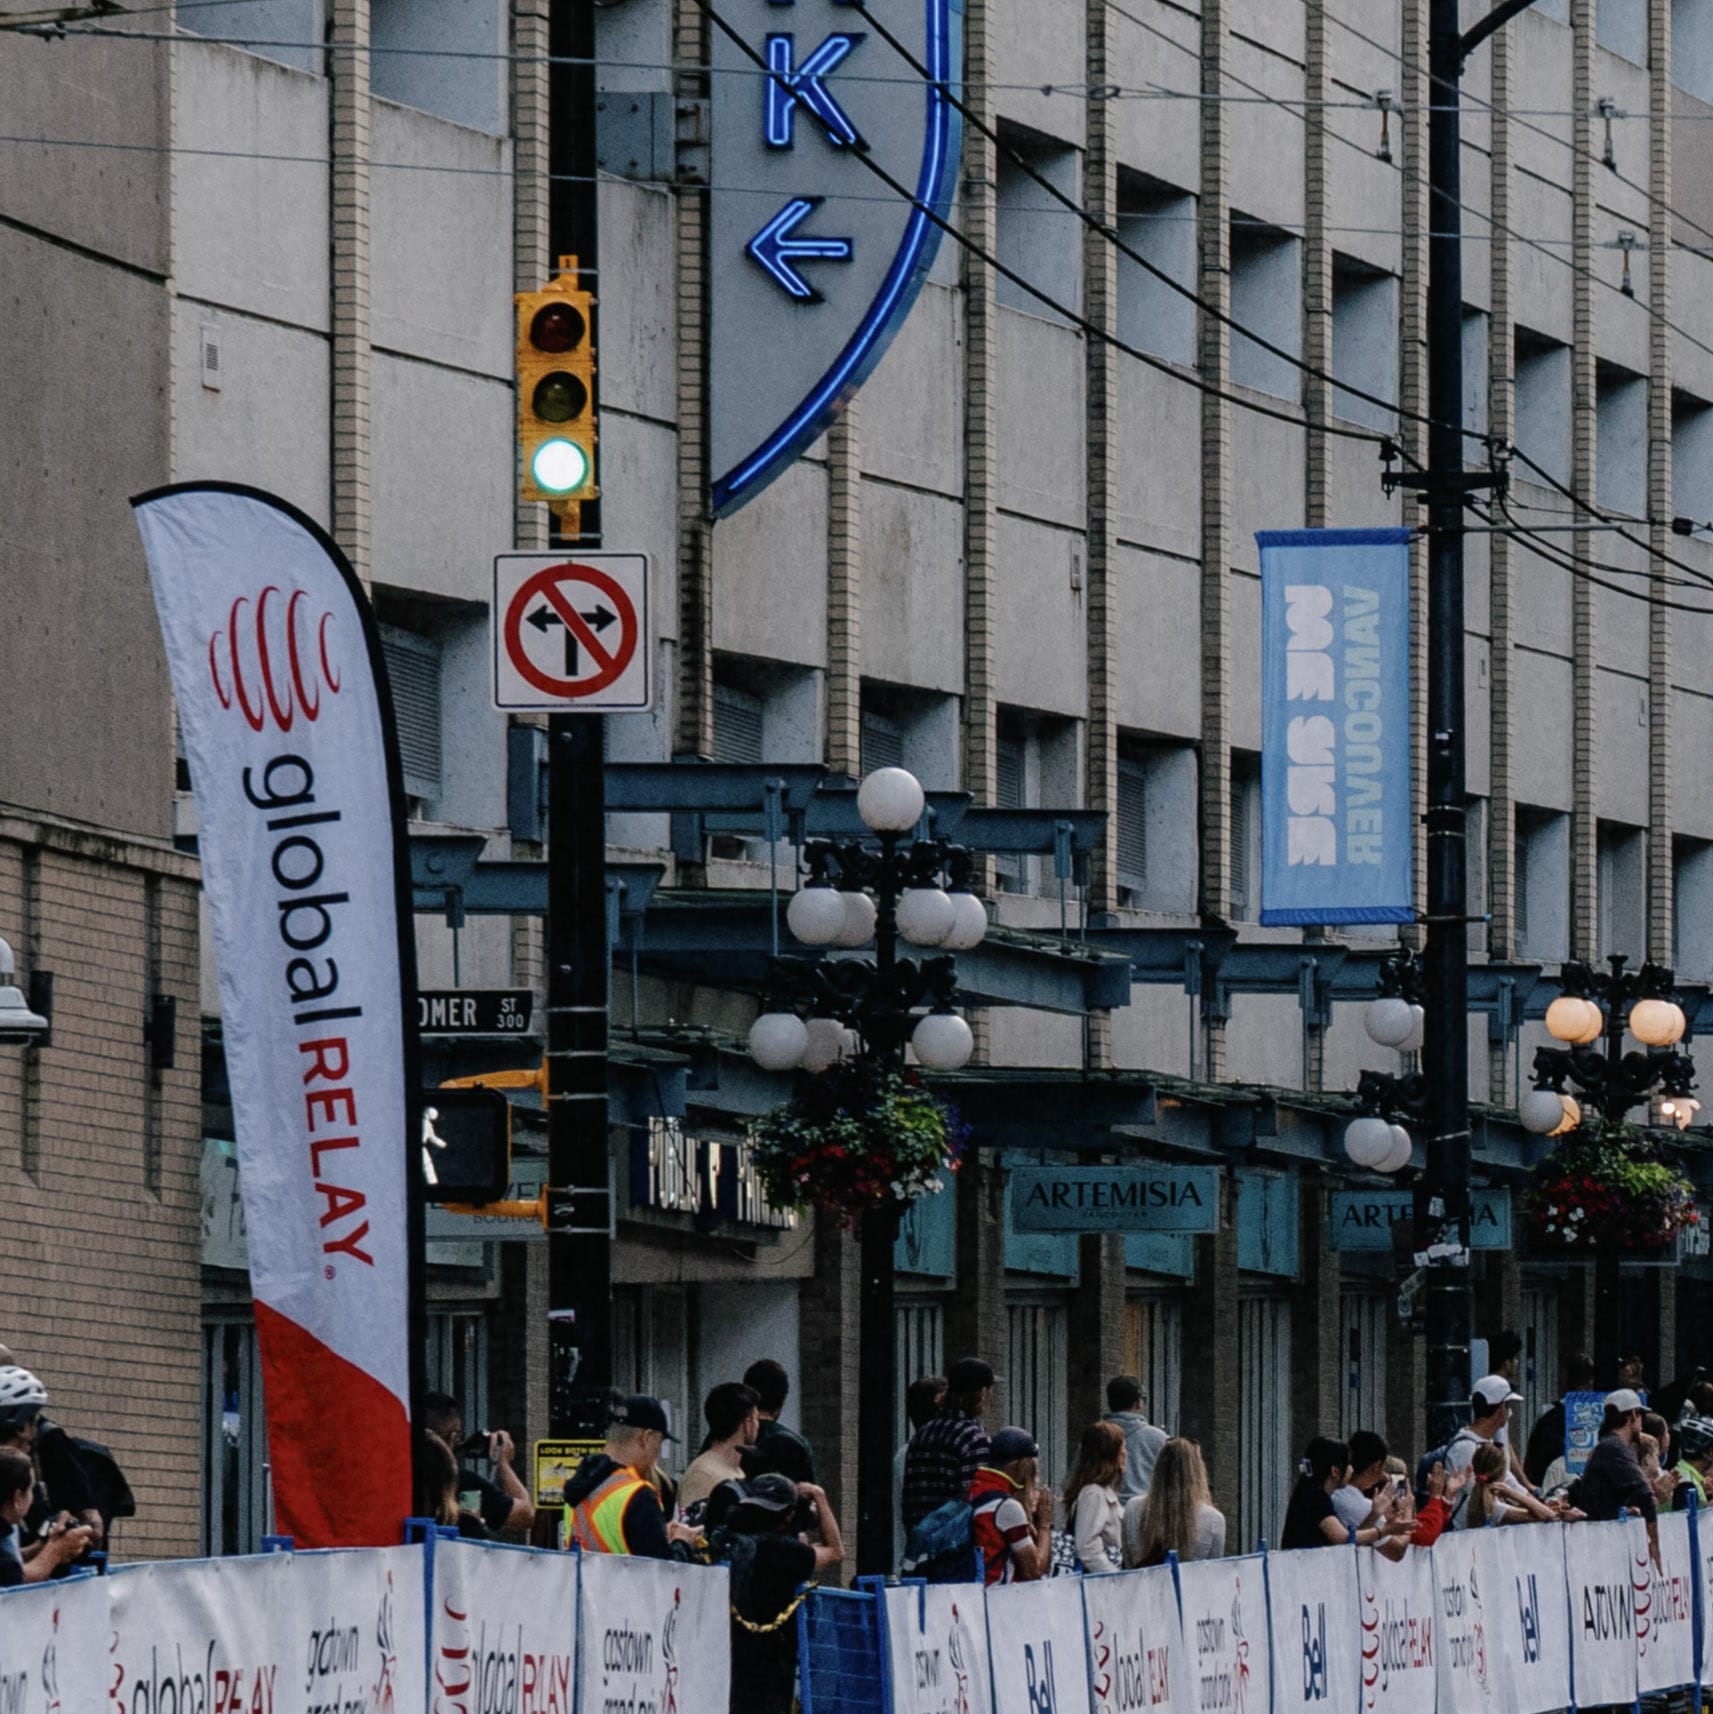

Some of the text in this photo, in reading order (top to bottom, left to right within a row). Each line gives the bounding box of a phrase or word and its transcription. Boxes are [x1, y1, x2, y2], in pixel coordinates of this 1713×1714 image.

[242, 753, 374, 1268] global RELAY
[501, 997, 517, 1012] ST
[496, 1014, 524, 1028] 300
[1026, 1181, 1202, 1208] ARTEMISIA
[1301, 1601, 1328, 1702] Bell
